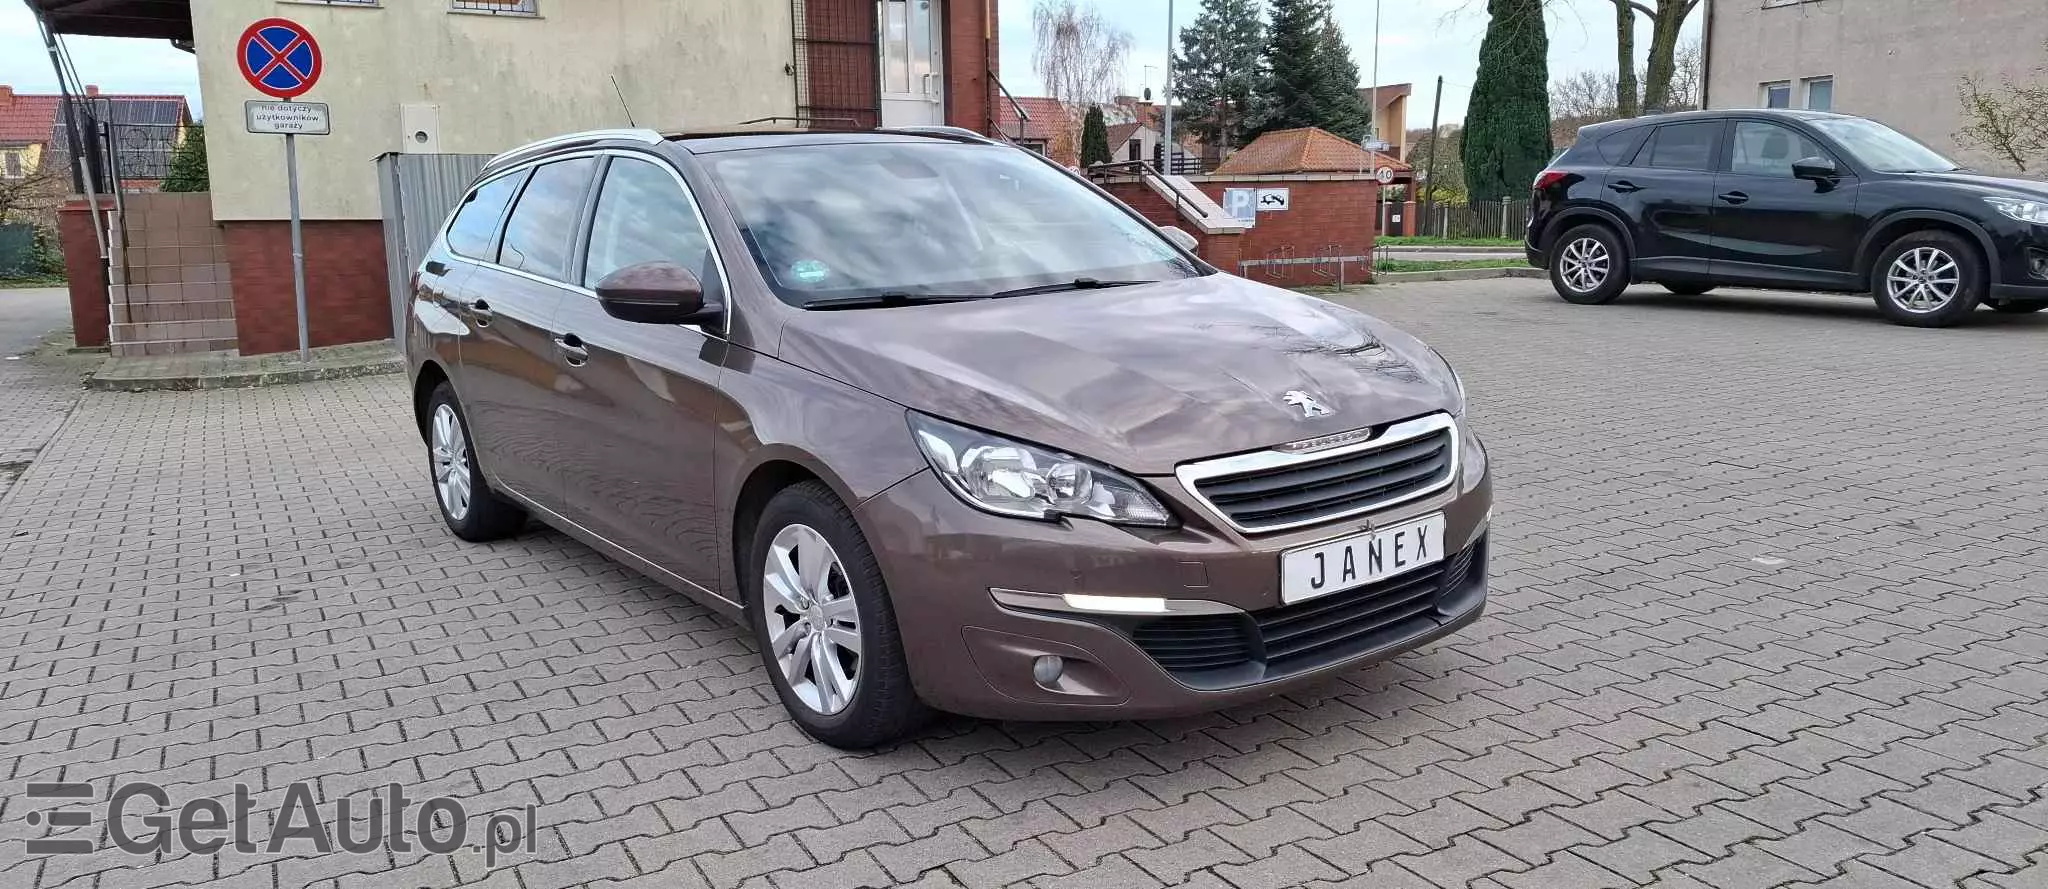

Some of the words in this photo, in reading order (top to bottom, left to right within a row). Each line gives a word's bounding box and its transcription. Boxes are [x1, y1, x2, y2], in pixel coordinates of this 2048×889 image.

[278, 104, 312, 113] dotyczy
[274, 121, 303, 129] garaży
[1232, 190, 1250, 218] P
[1311, 525, 1428, 589] JANEX
